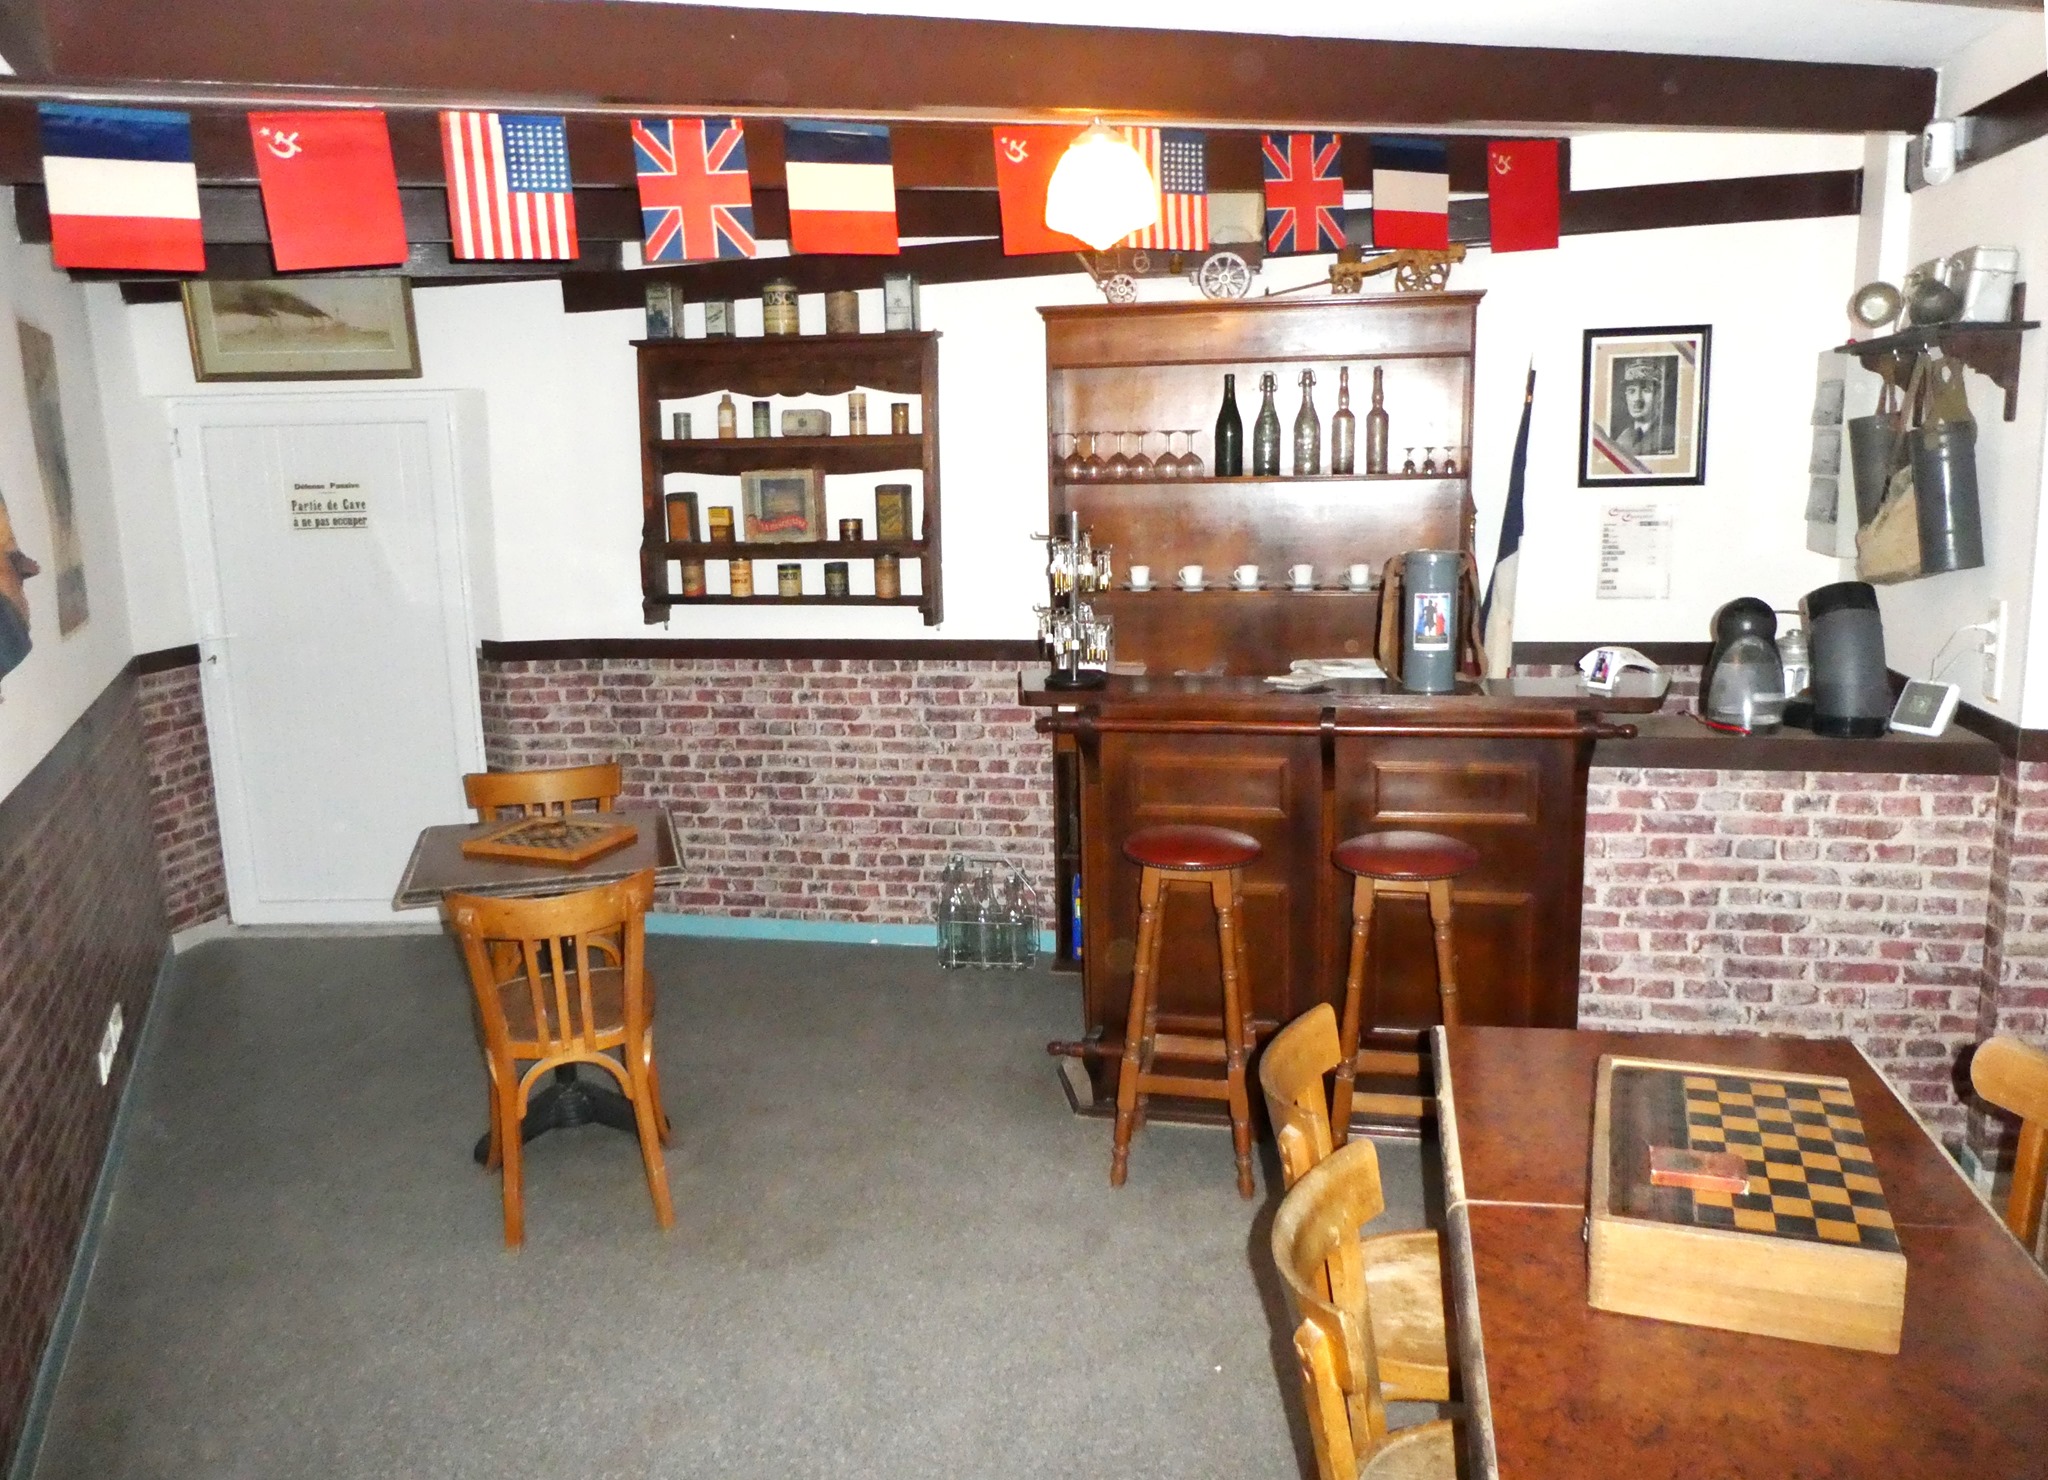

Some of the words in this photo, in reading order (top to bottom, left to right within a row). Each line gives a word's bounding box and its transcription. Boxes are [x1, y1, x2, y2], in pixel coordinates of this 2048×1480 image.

[292, 500, 322, 511] Partie
[327, 499, 338, 510] de
[343, 499, 366, 510] Cave
[302, 519, 312, 527] ne
[315, 518, 330, 528] pas
[333, 517, 367, 527] occuper
